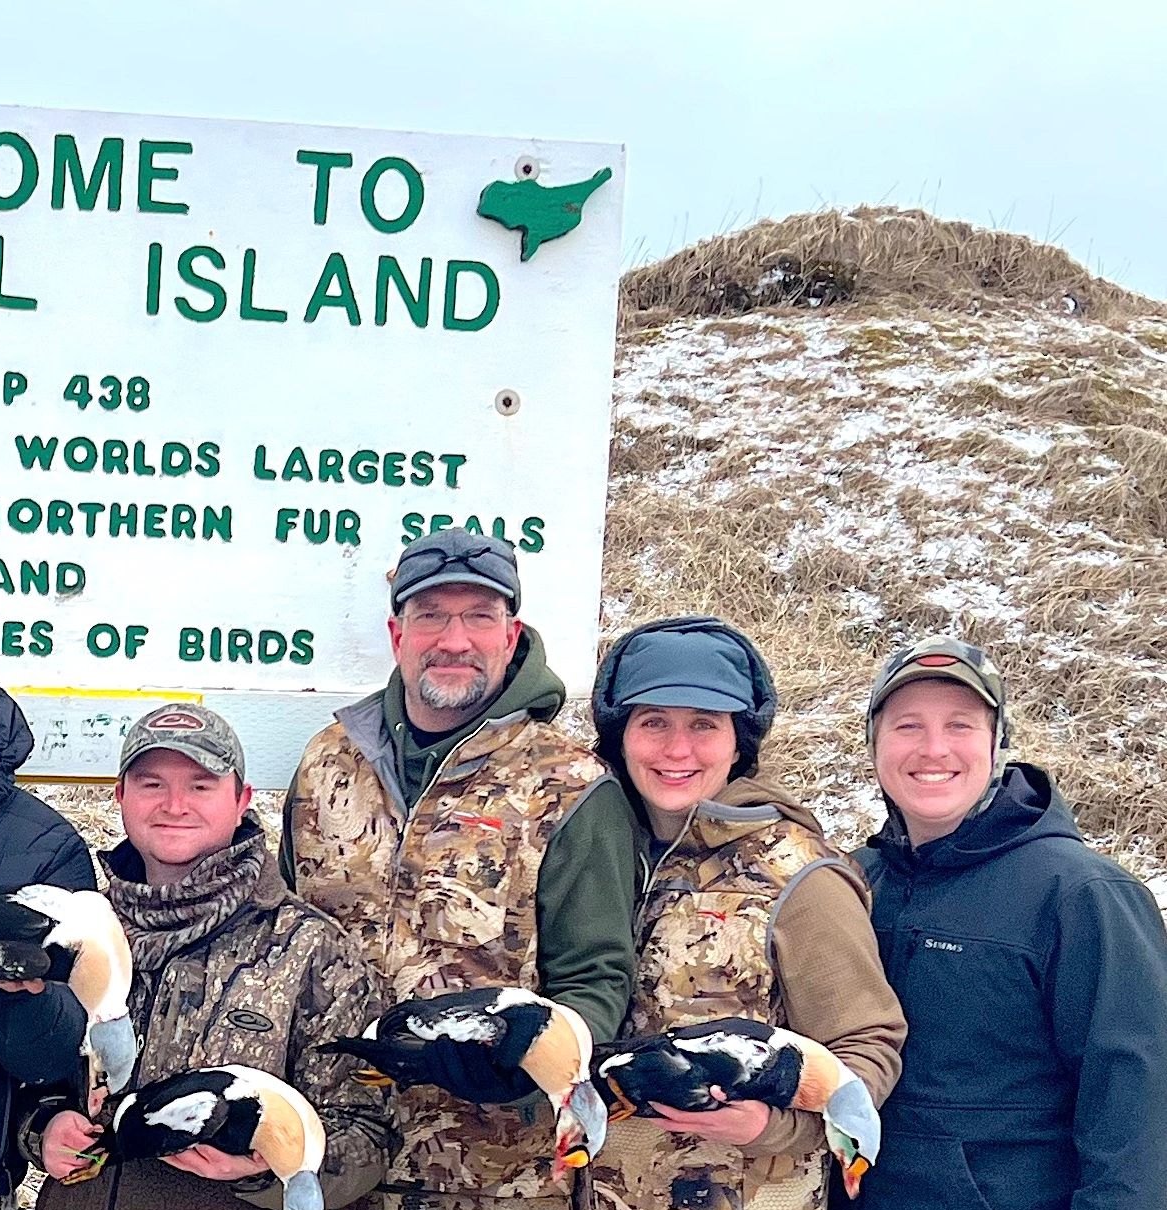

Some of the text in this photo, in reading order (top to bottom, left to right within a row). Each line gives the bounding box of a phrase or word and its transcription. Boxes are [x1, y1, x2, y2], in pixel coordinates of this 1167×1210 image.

[296, 149, 425, 235] TO
[146, 241, 501, 332] ISLAND
[63, 374, 151, 412] 438
[15, 434, 220, 478] WORLDS
[253, 445, 467, 488] LARGEST
[275, 508, 362, 547] FUR
[86, 623, 149, 659] OF
[178, 628, 315, 666] BIRDS
